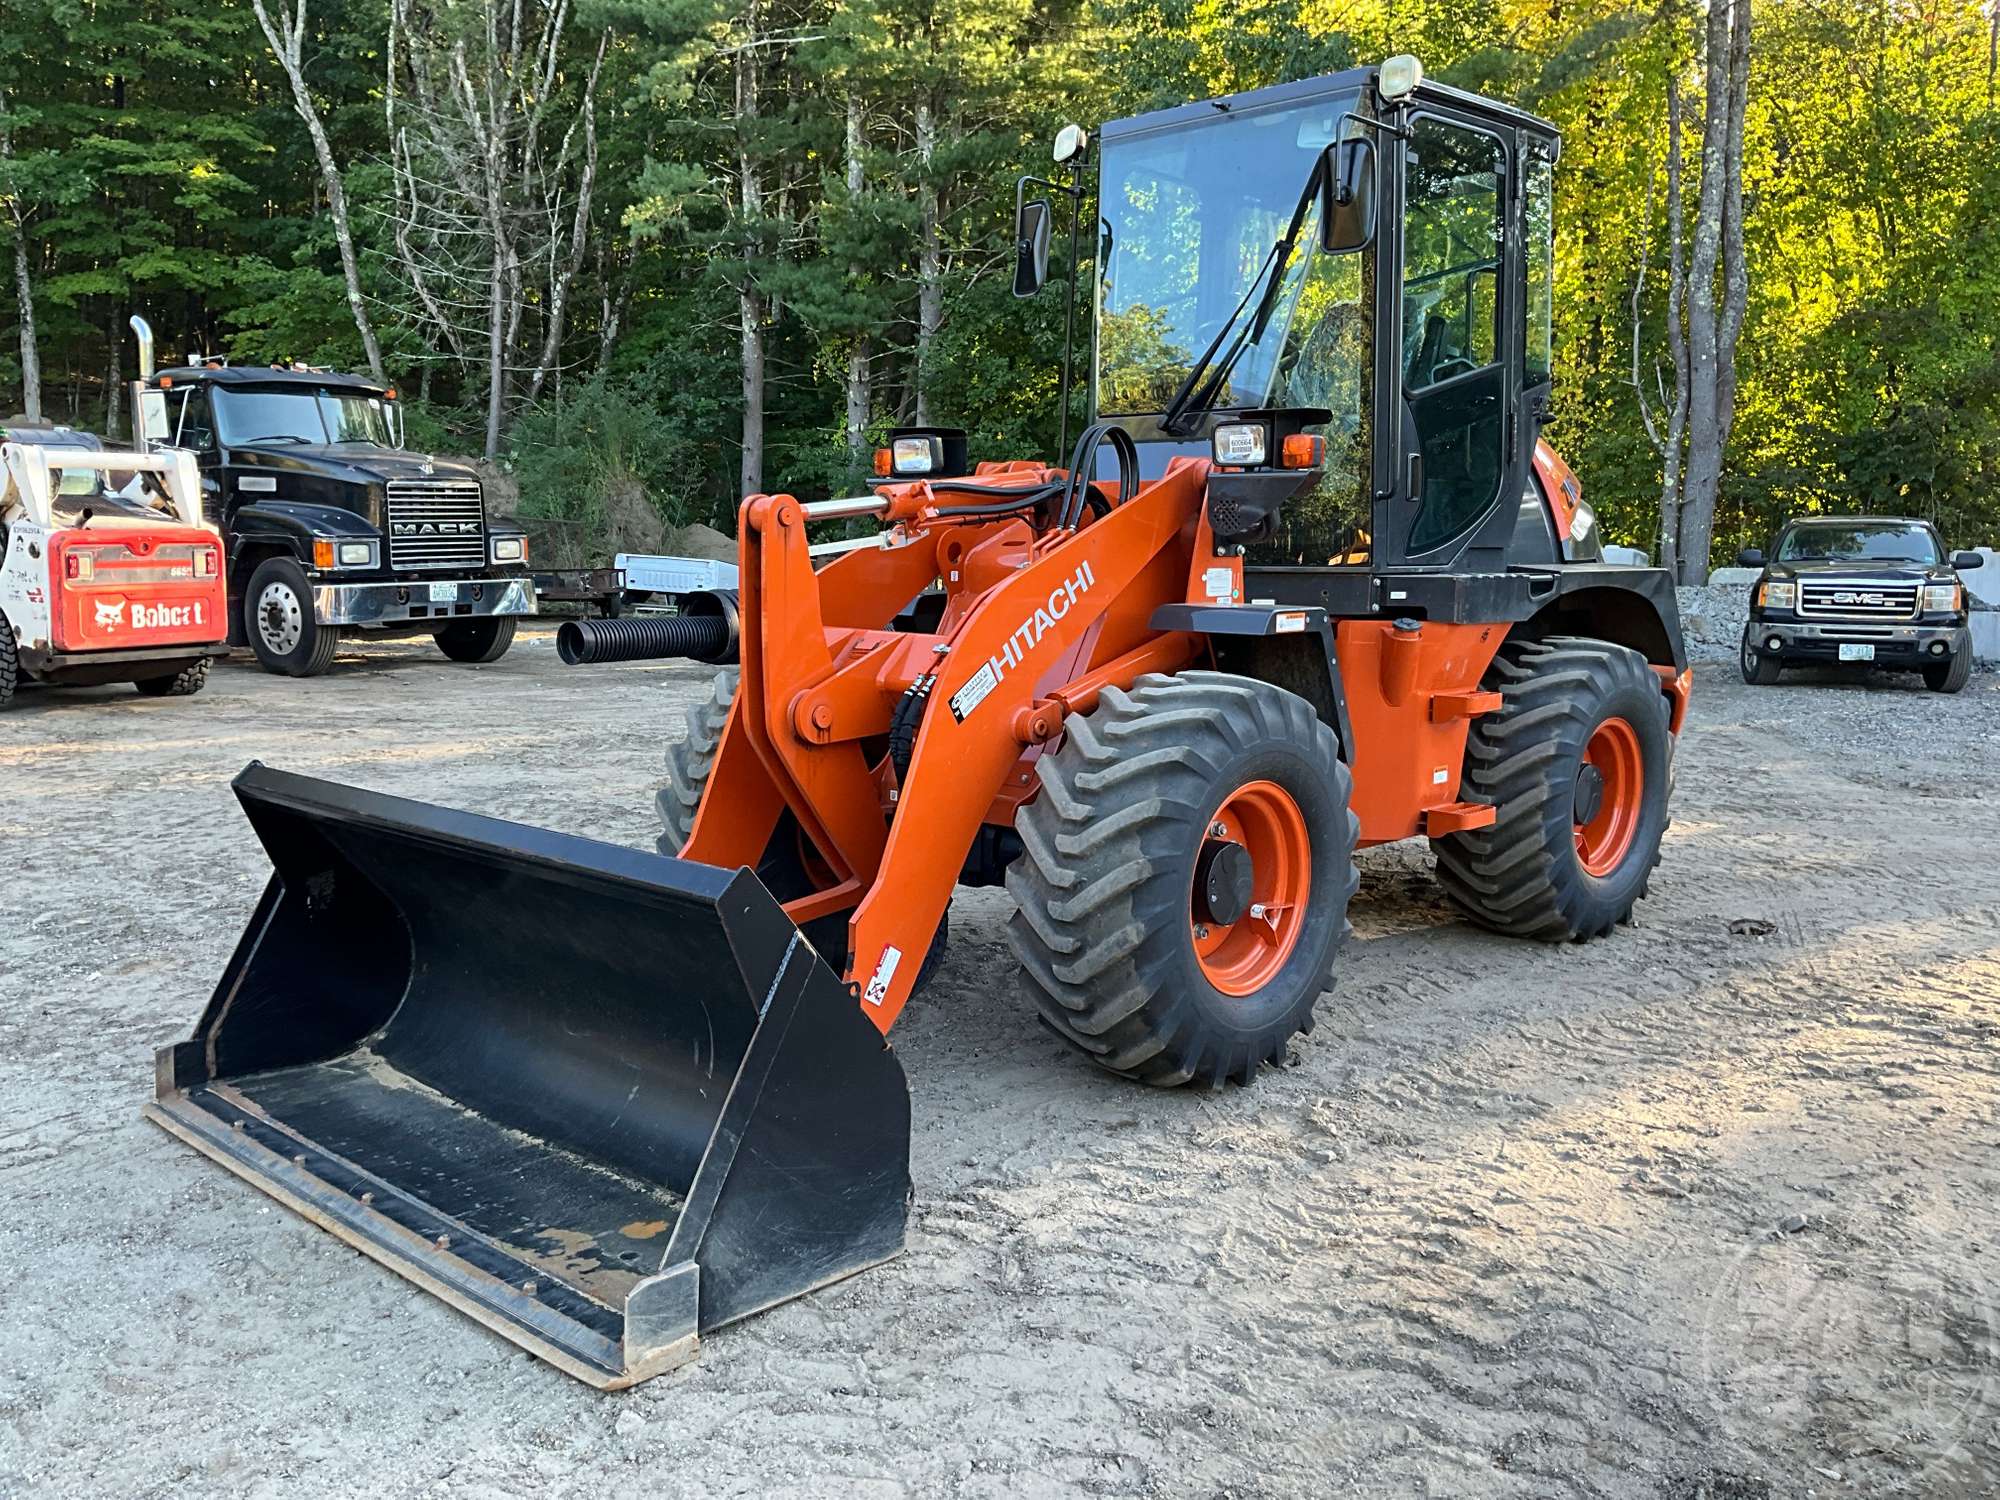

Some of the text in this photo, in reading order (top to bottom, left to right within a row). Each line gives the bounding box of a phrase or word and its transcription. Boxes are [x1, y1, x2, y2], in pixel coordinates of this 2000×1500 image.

[394, 523, 479, 535] MACK
[1833, 592, 1884, 604] GMC
[990, 559, 1095, 682] HITACHI
